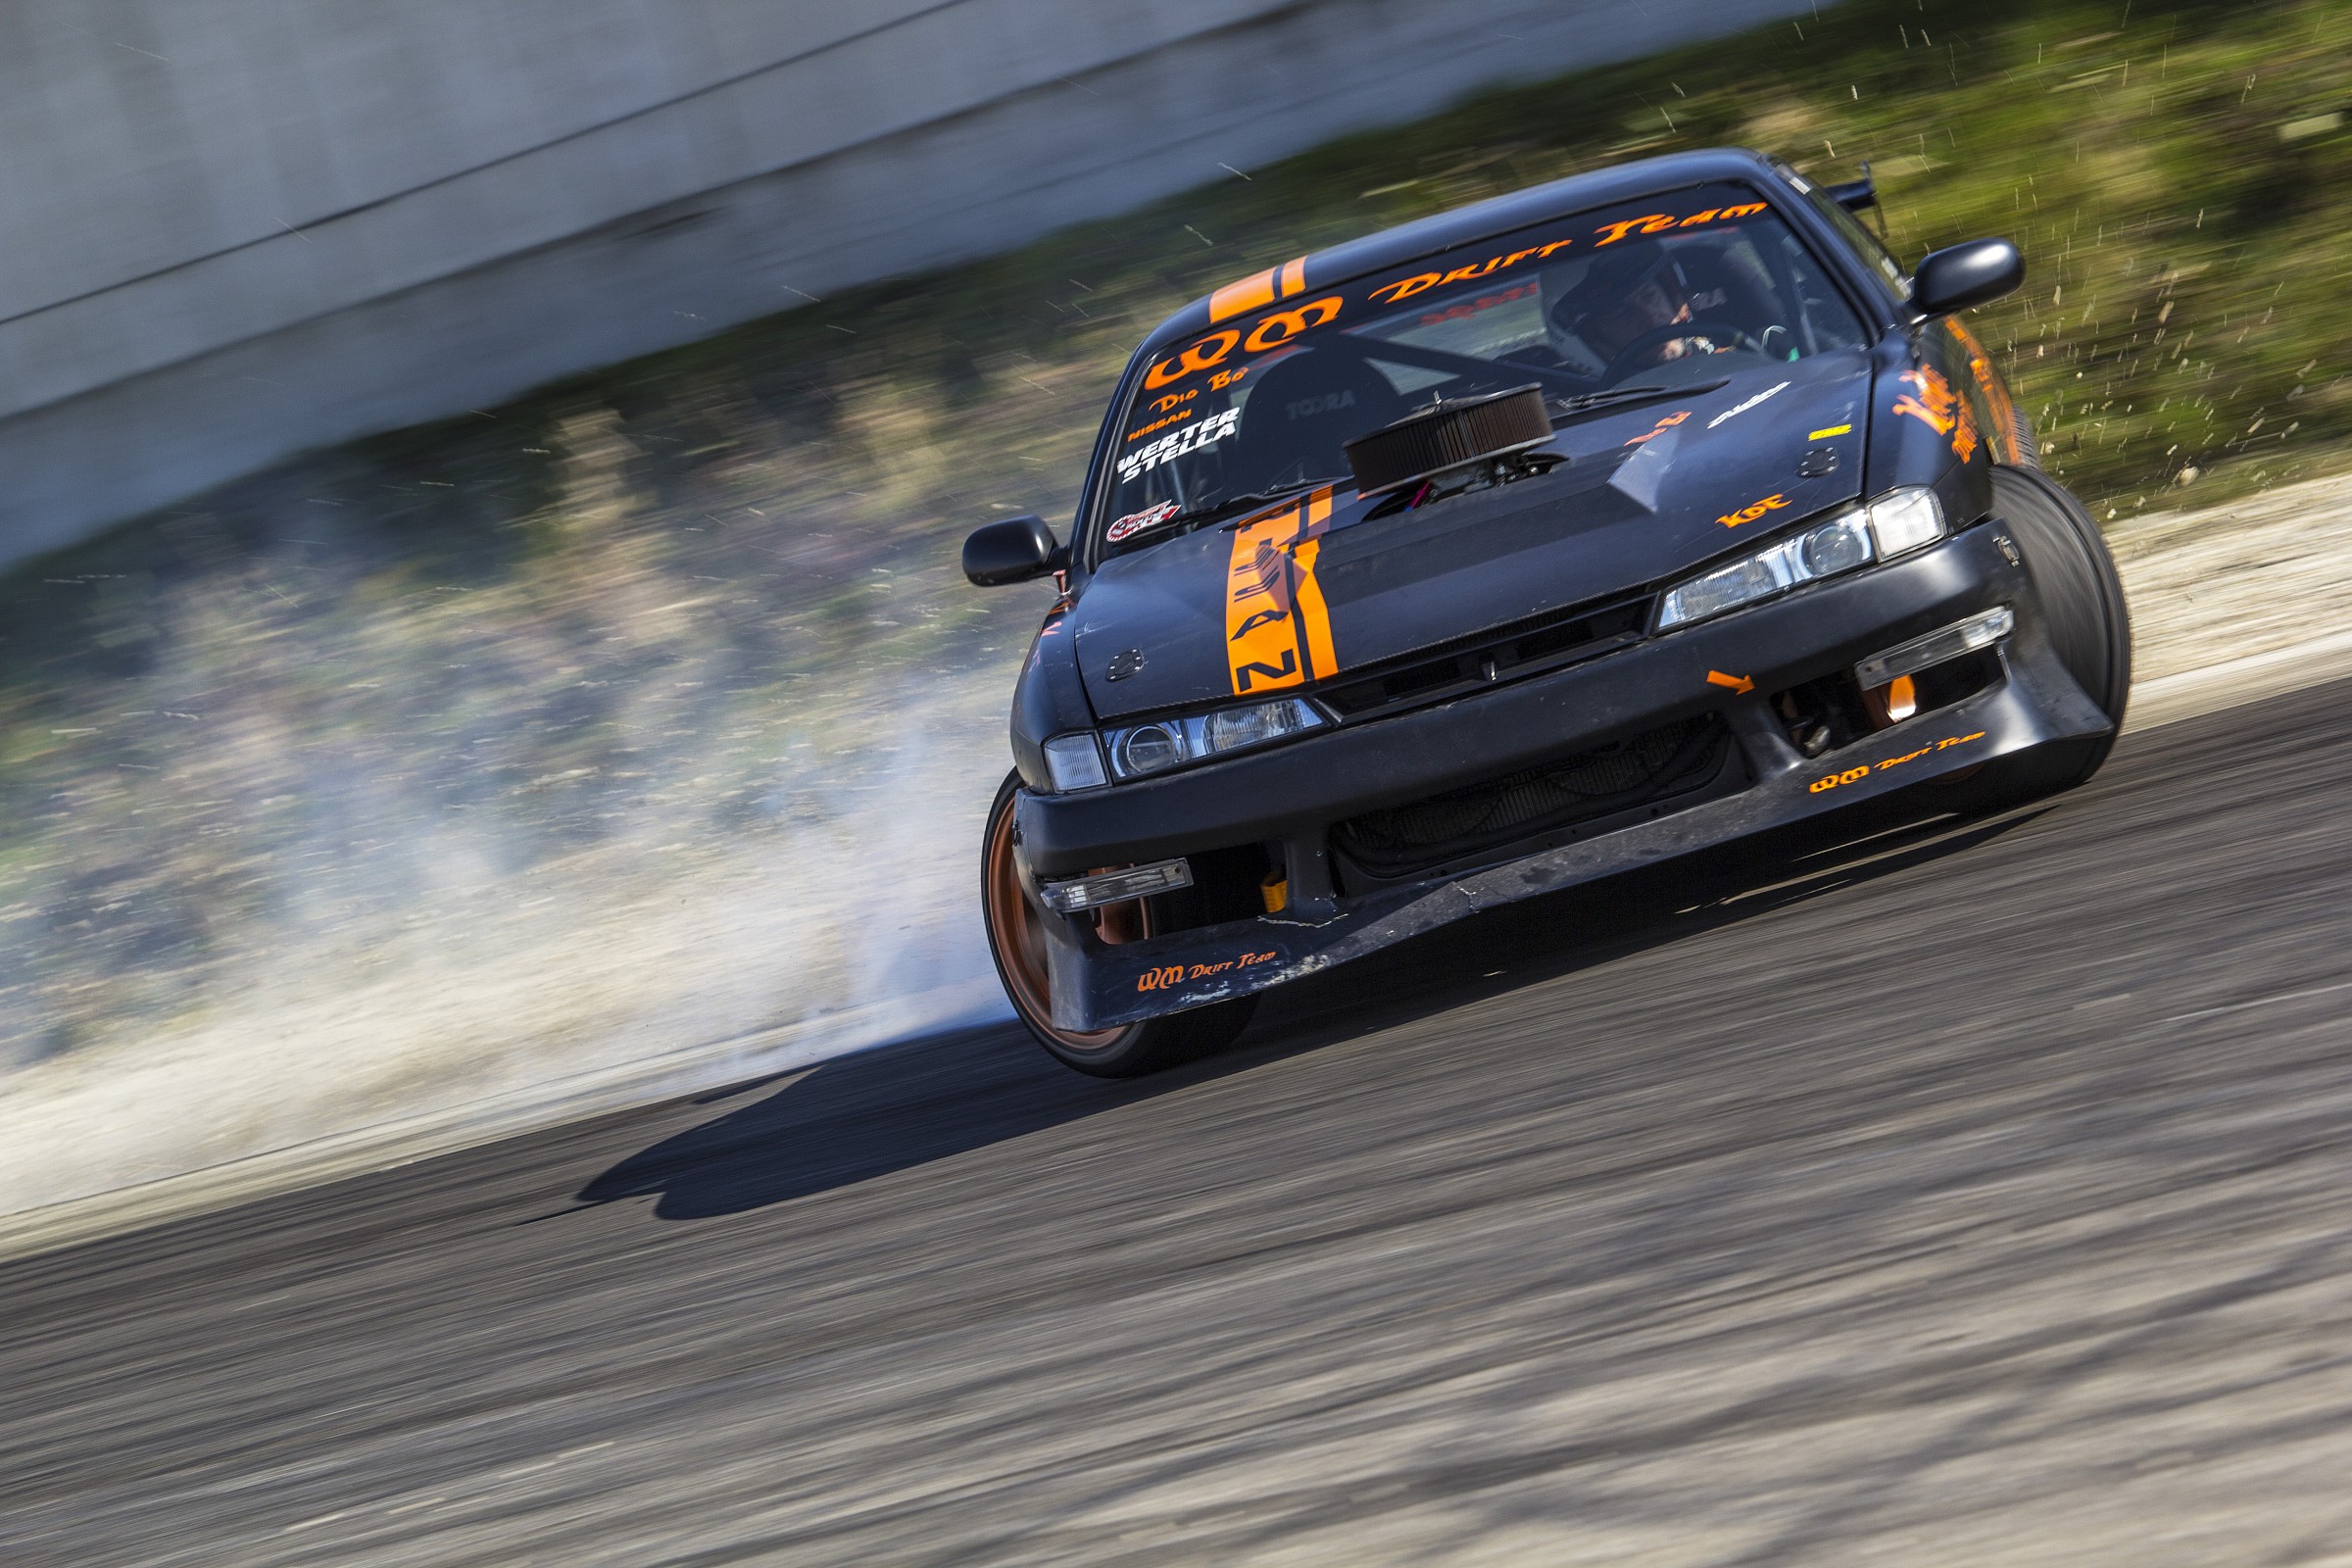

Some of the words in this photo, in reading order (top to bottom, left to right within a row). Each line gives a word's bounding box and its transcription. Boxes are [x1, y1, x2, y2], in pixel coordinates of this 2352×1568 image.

[1116, 407, 1240, 473] WERTER
[1121, 421, 1237, 484] STELLA
[1127, 409, 1192, 443] NISSAN
